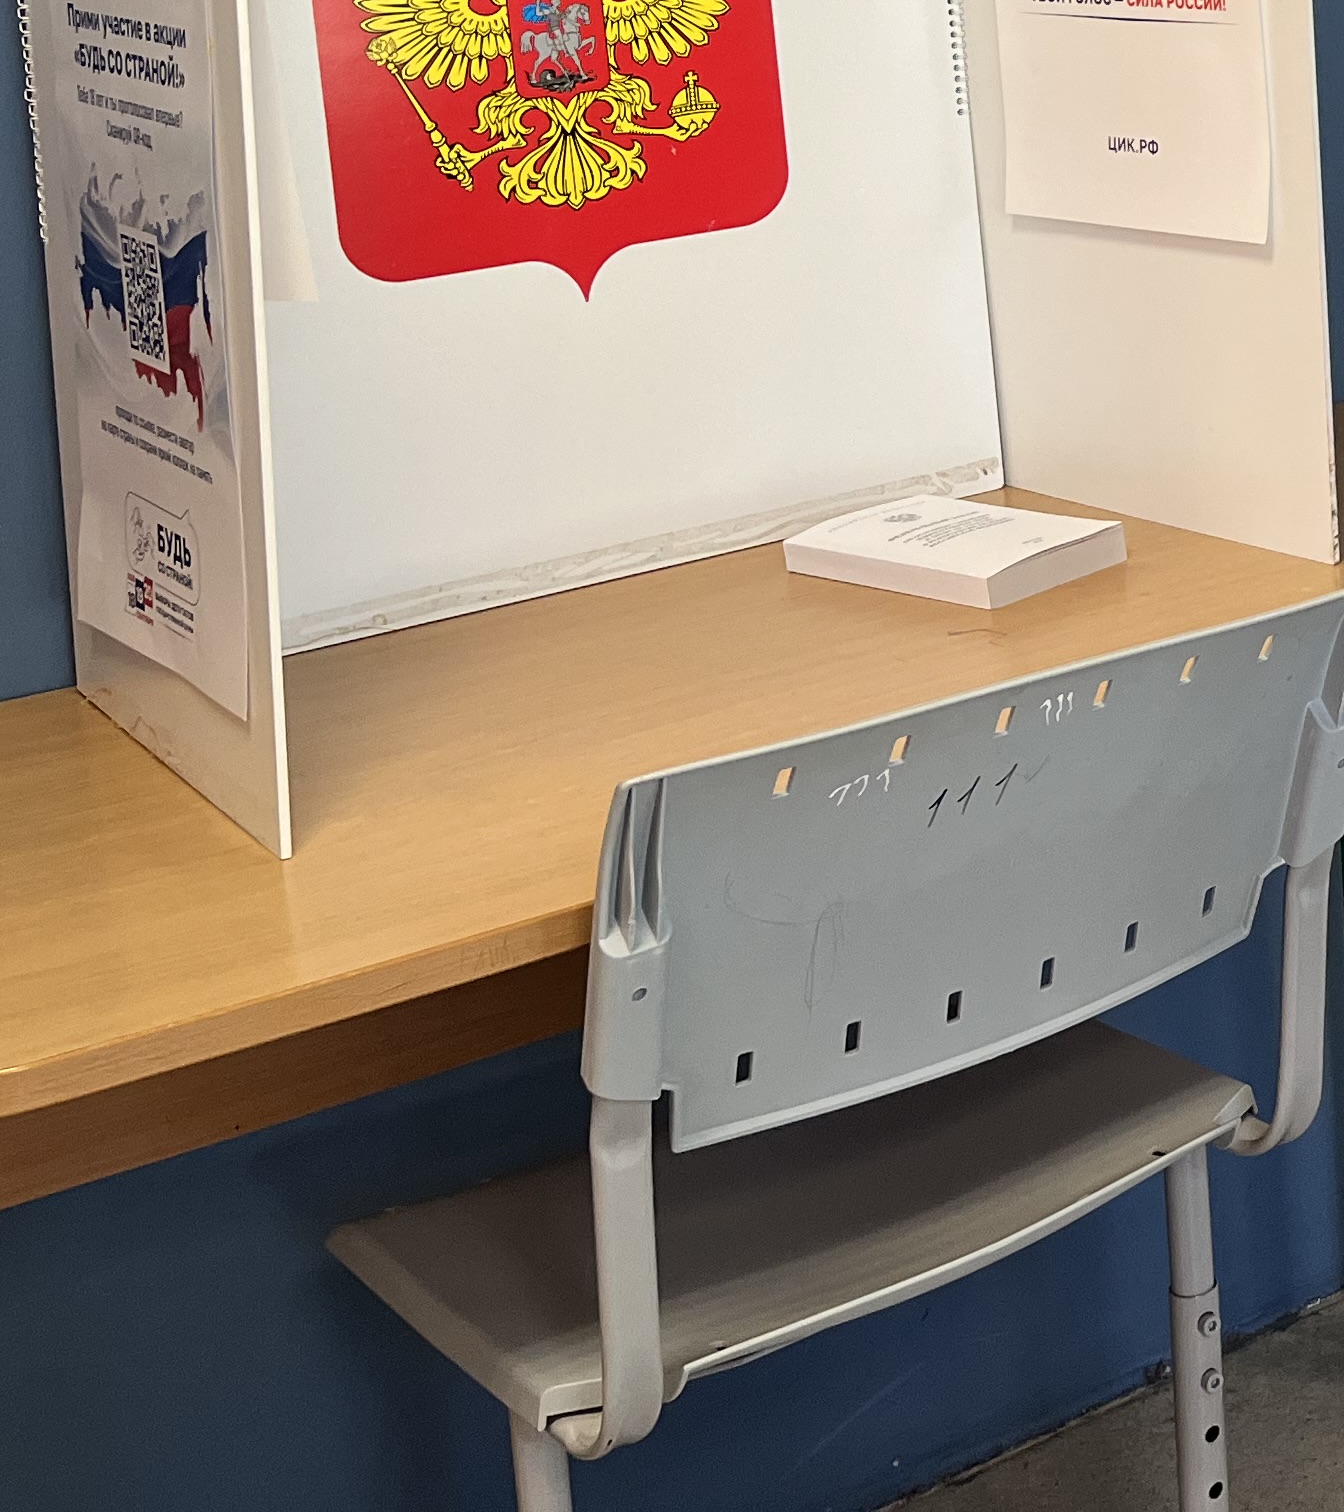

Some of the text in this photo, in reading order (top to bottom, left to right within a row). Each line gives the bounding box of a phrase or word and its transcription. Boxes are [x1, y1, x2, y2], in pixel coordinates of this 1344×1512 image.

[66, 2, 187, 50] Прими участие в акции
[74, 42, 186, 89] «БУДЬ СО СТРАНОЙ!»
[1107, 135, 1159, 156] ЦИК.РФ
[157, 523, 192, 569] БУДЬ
